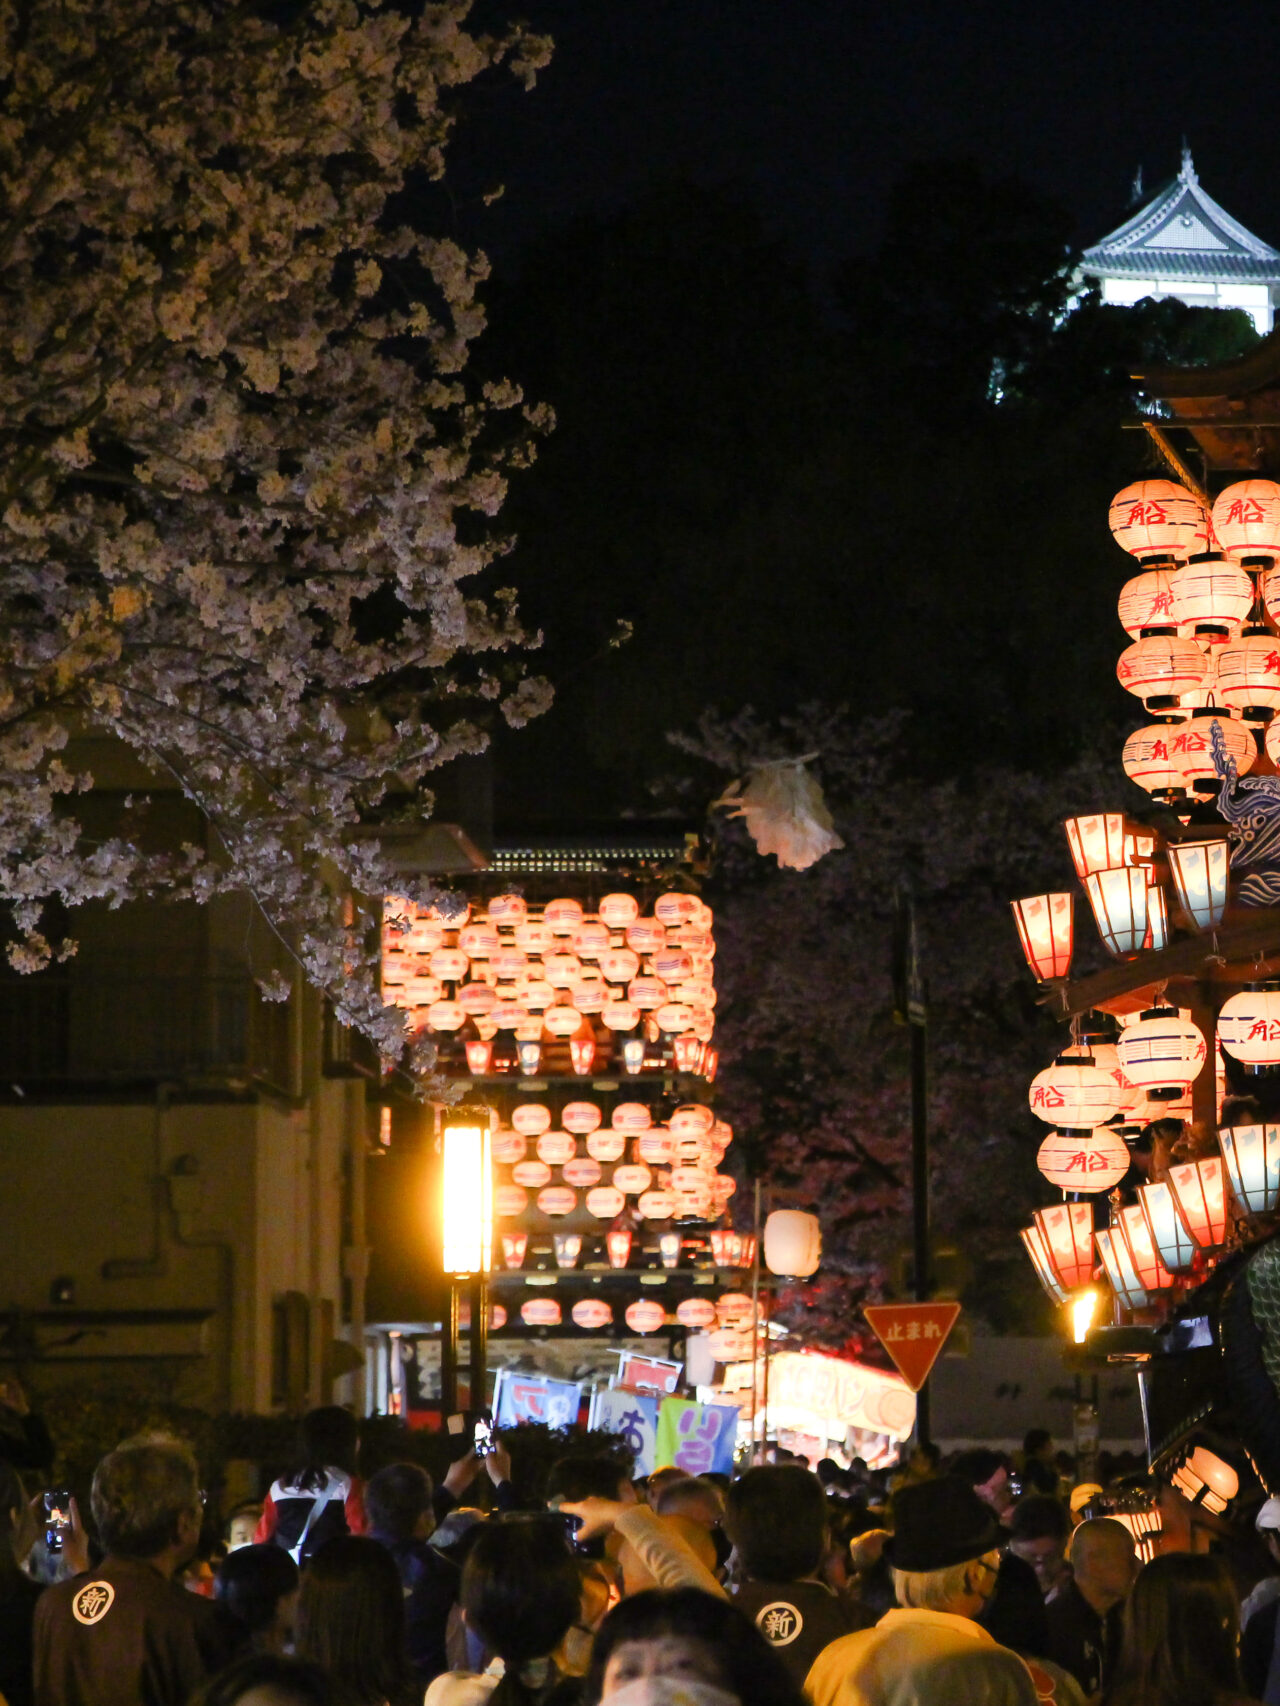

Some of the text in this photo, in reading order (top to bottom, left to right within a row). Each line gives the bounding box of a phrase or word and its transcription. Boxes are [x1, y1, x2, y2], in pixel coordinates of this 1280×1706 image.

[1127, 500, 1168, 525] 船
[1226, 497, 1267, 524] 船
[1173, 732, 1207, 753] 船
[1033, 1086, 1066, 1108] 船
[1066, 1151, 1109, 1172] 船
[885, 1321, 942, 1341] 止まれ
[80, 1588, 106, 1617] 新
[765, 1610, 793, 1638] 新
